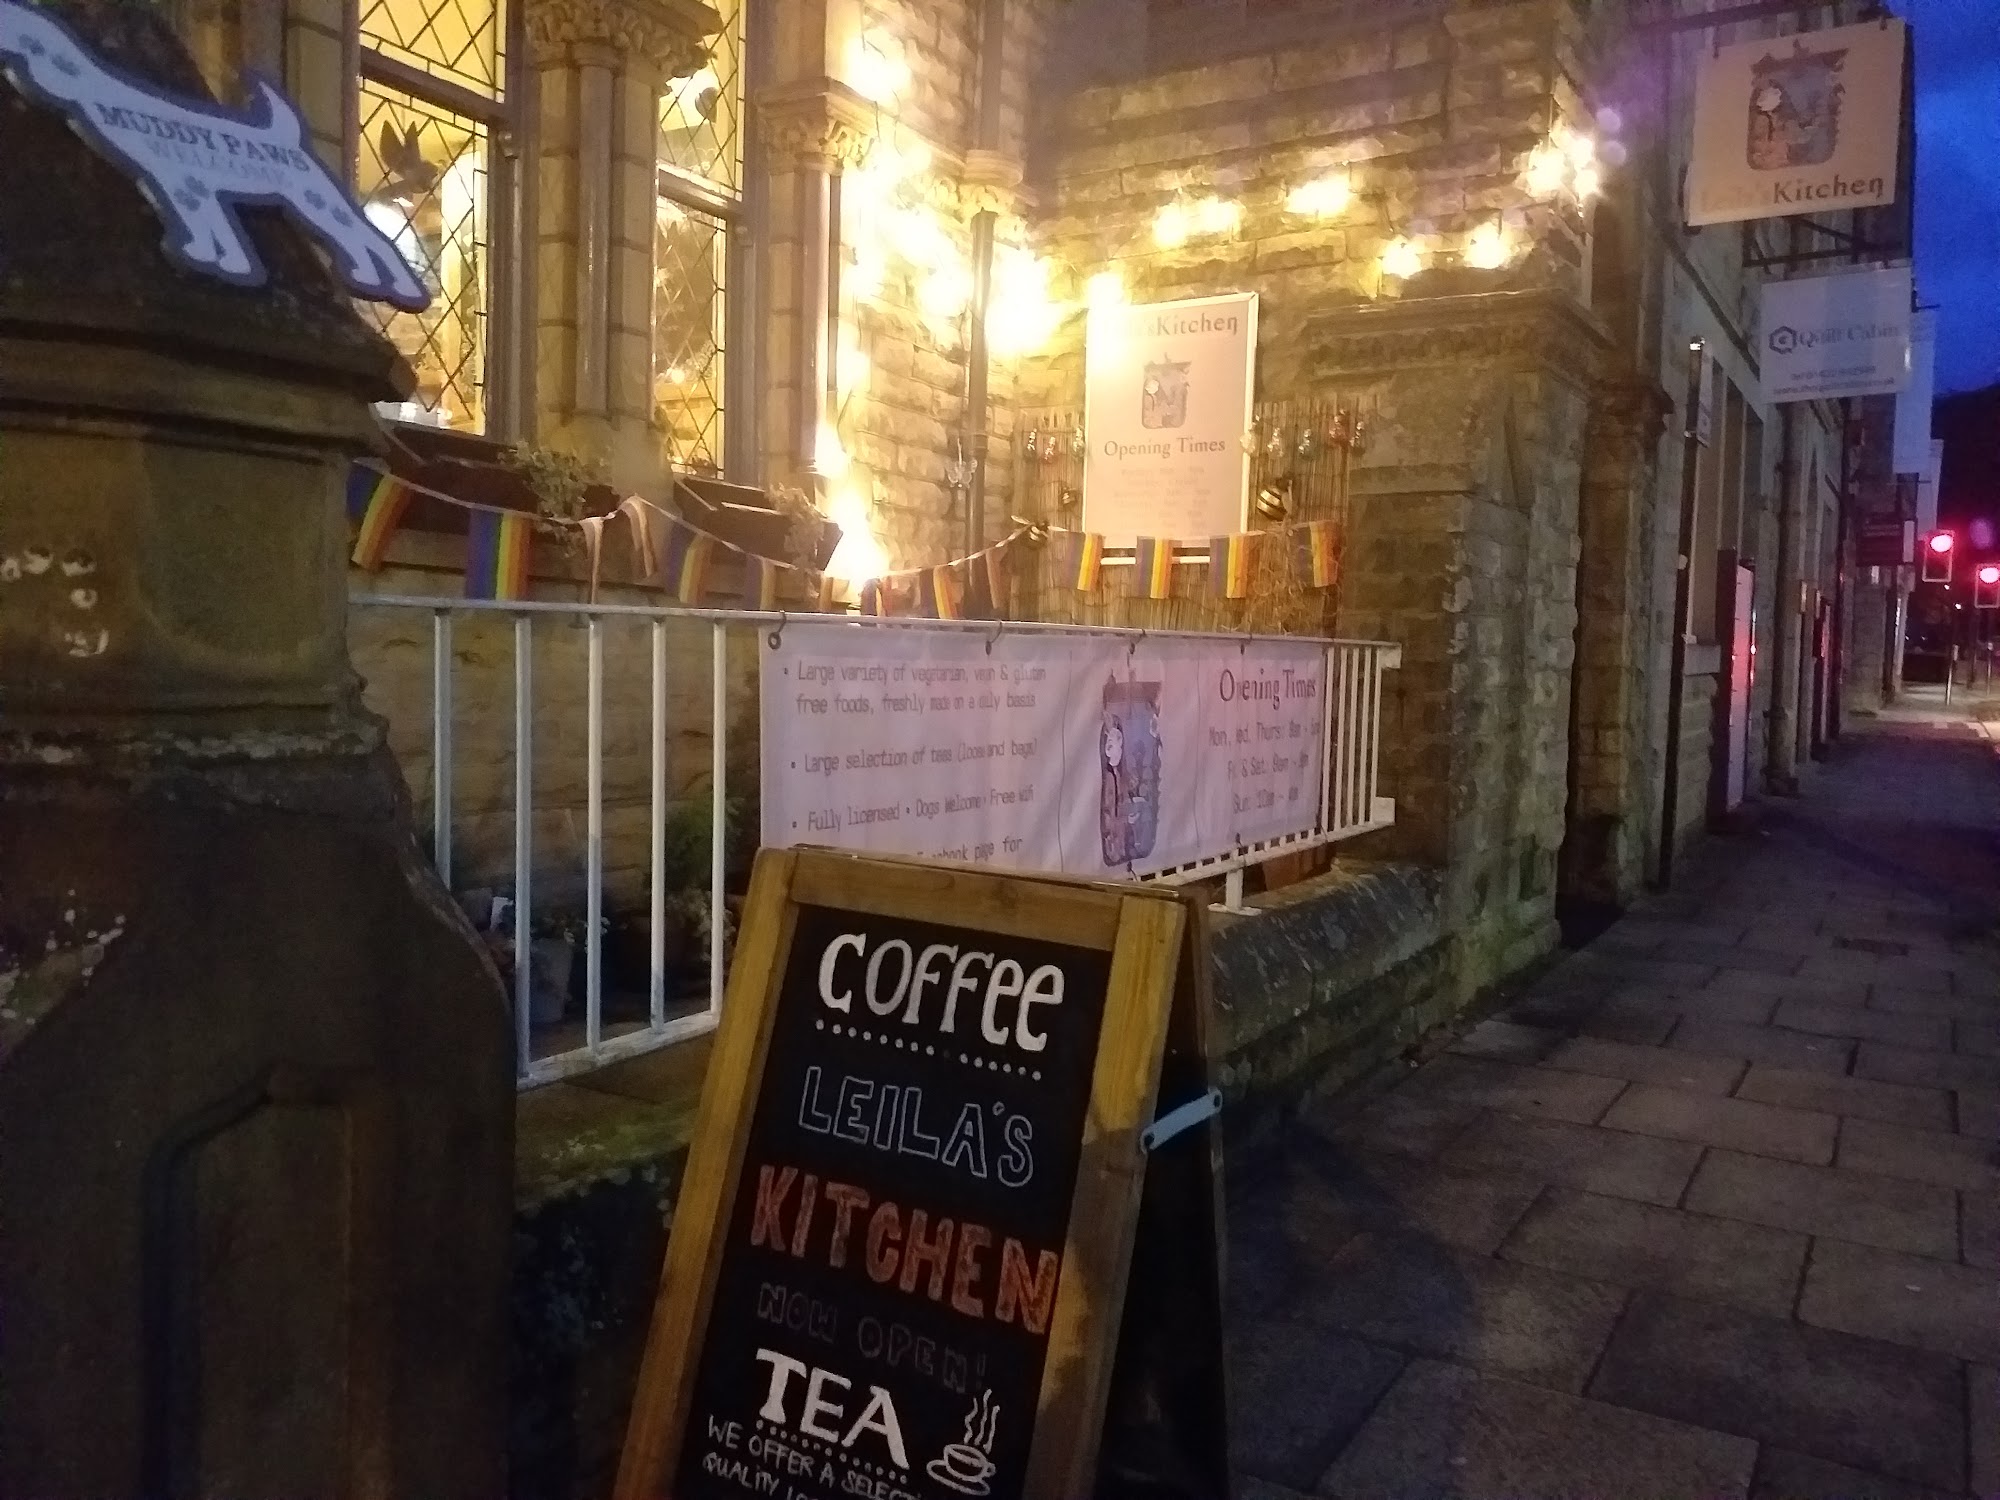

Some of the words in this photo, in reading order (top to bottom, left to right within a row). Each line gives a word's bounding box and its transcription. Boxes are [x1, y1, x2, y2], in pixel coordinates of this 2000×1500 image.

[94, 101, 217, 151] MUDDY
[219, 132, 310, 172] PAWS
[1773, 173, 1884, 205] Kitchen
[1156, 311, 1238, 337] Kitchen
[1103, 437, 1172, 461] Opening
[1176, 434, 1226, 454] Times
[798, 660, 835, 686] Large
[840, 662, 889, 686] variety
[893, 663, 906, 681] of
[1282, 668, 1317, 699] Times
[796, 694, 828, 714] free
[834, 692, 875, 715] foods,
[882, 691, 926, 714] freshly
[805, 754, 841, 776] Large
[846, 749, 908, 770] selection
[912, 746, 926, 765] of
[808, 808, 842, 832] Fully
[848, 803, 901, 826] licensed
[916, 798, 940, 819] Dogs
[1002, 836, 1023, 853] for
[799, 1066, 1034, 1188] LEILA'S
[750, 1164, 1059, 1334] KITCHEN
[757, 1282, 838, 1343] NOW
[755, 1347, 910, 1470] TEA
[708, 1414, 744, 1449] WE
[748, 1434, 815, 1478] OFFER
[818, 1462, 836, 1488] A
